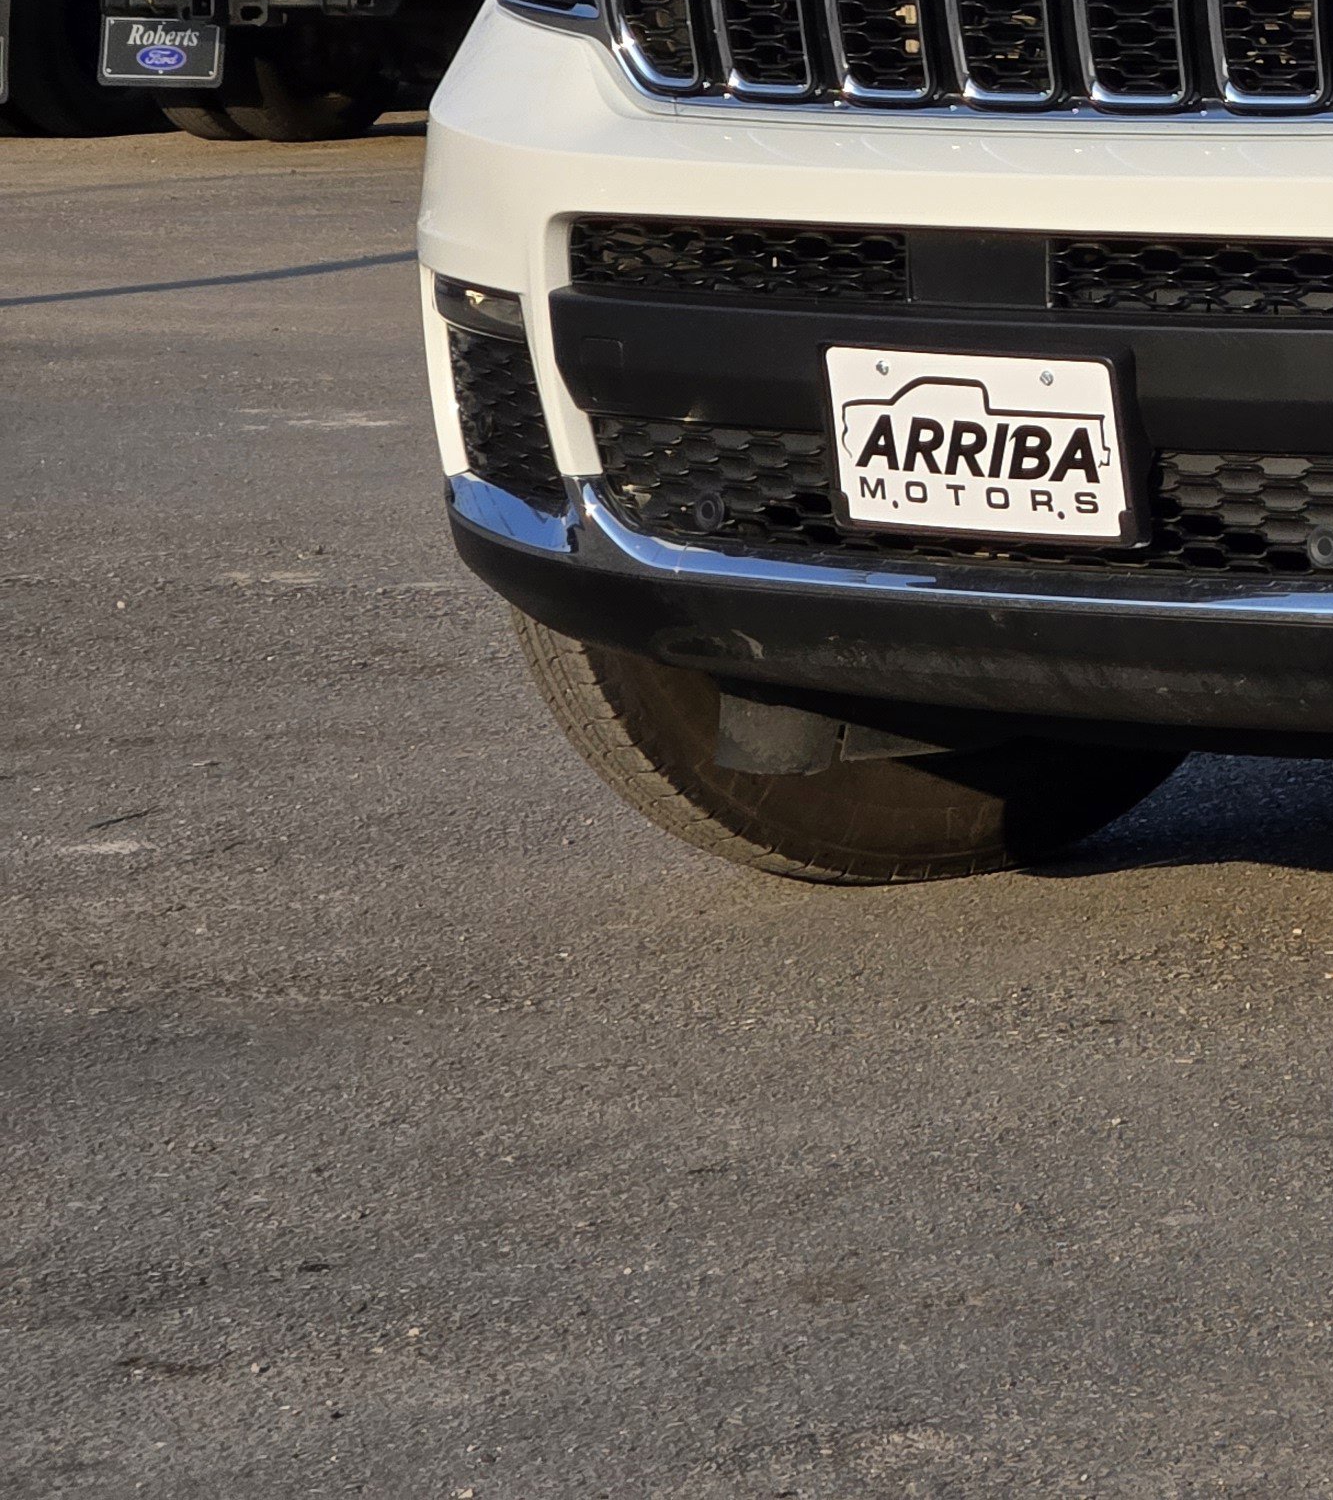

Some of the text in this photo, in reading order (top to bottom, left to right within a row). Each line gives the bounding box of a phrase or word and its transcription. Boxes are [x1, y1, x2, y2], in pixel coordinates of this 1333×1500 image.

[127, 24, 200, 46] Roberts
[144, 50, 179, 65] Ford
[855, 414, 1101, 484] ARRIBA
